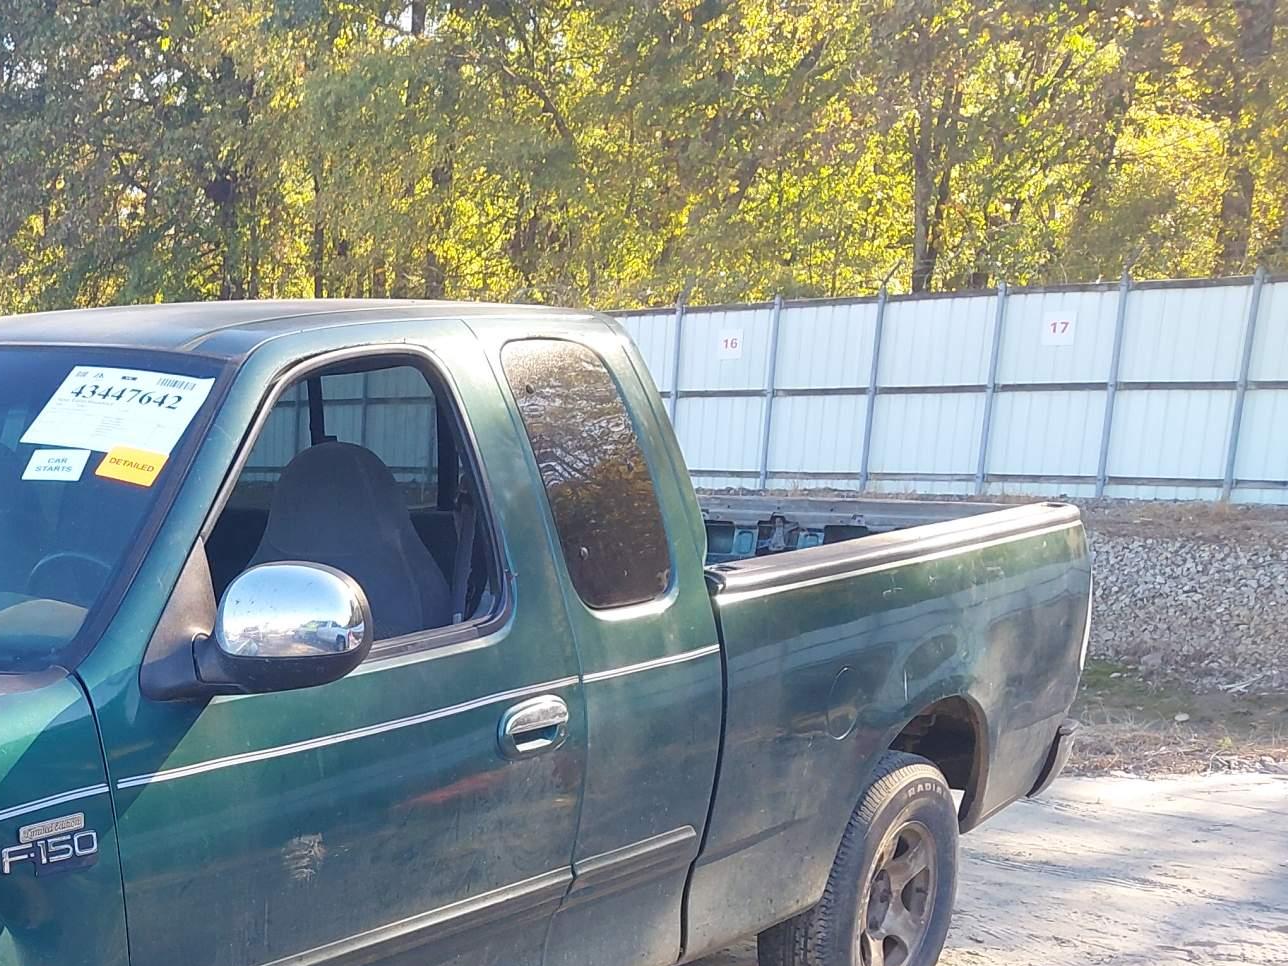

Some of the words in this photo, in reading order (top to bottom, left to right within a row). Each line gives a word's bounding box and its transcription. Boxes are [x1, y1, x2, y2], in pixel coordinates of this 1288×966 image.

[1050, 321, 1070, 334] 17
[722, 337, 739, 349] 16
[70, 383, 183, 410] 43447642
[34, 465, 73, 473] STARTS
[108, 457, 155, 472] DETAILED
[1, 829, 98, 874] F-150
